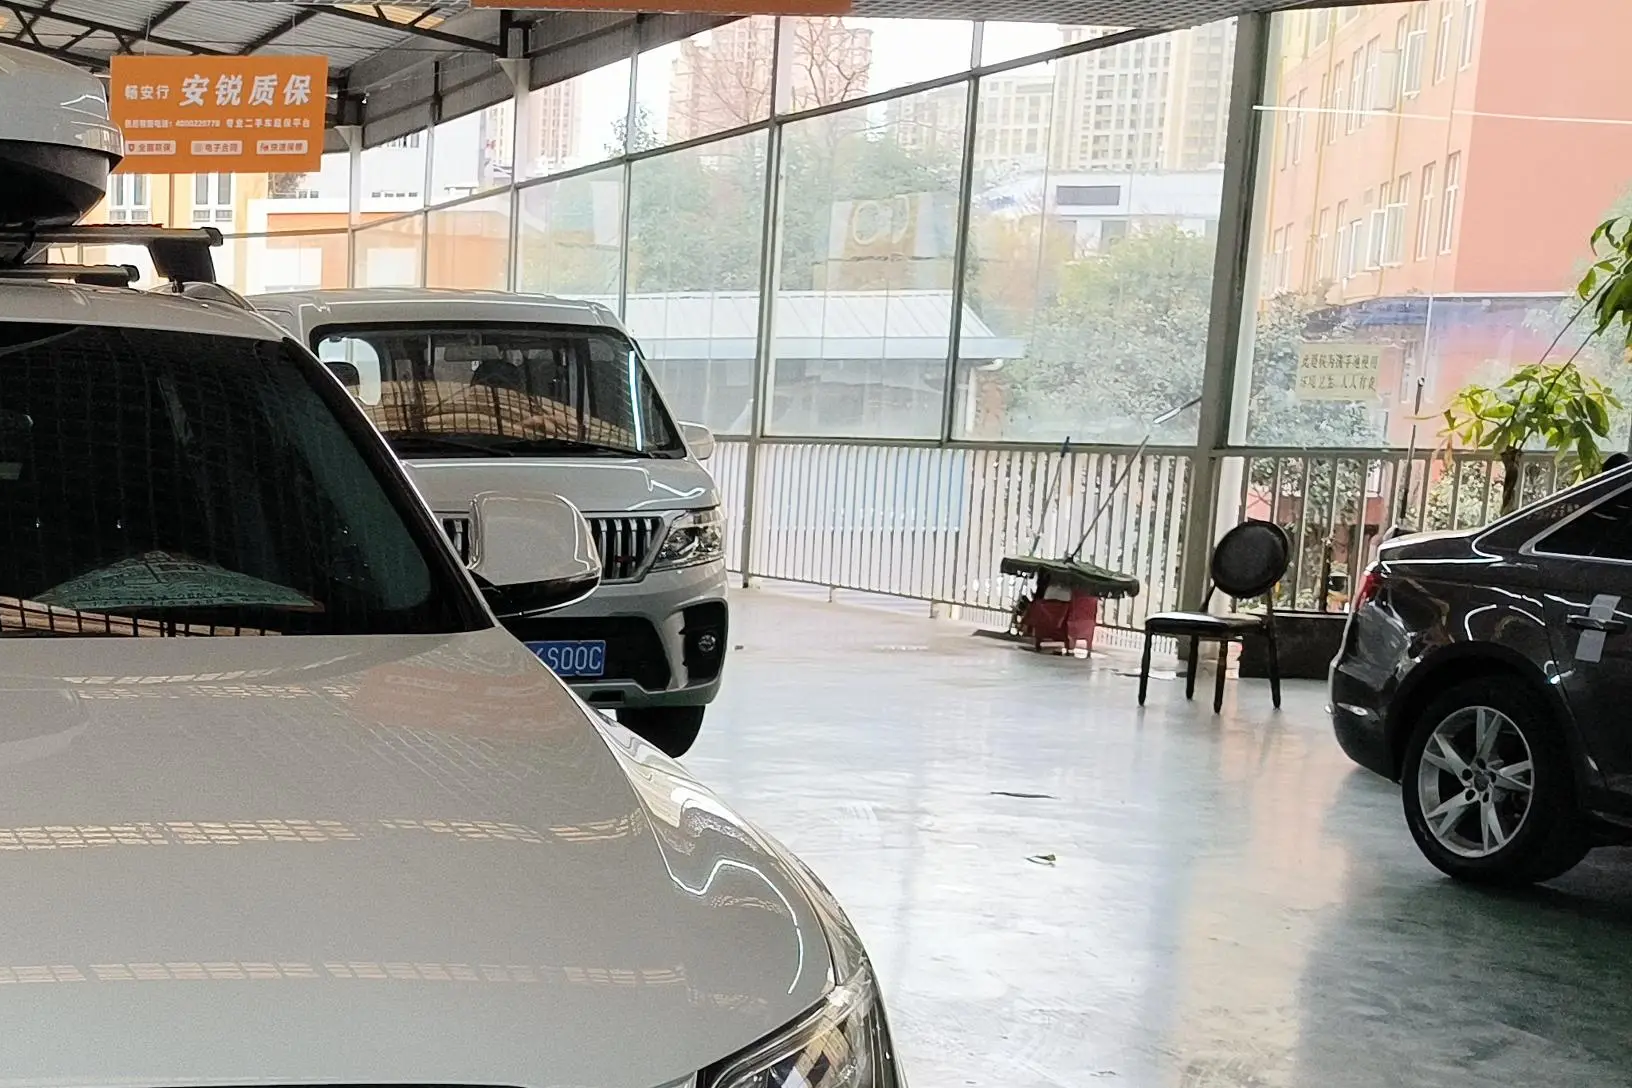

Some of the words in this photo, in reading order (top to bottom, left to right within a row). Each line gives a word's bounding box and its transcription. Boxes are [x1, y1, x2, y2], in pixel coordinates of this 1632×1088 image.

[124, 83, 170, 101] 畅安行
[179, 74, 312, 106] 安锐质保
[537, 647, 601, 670] S00C
